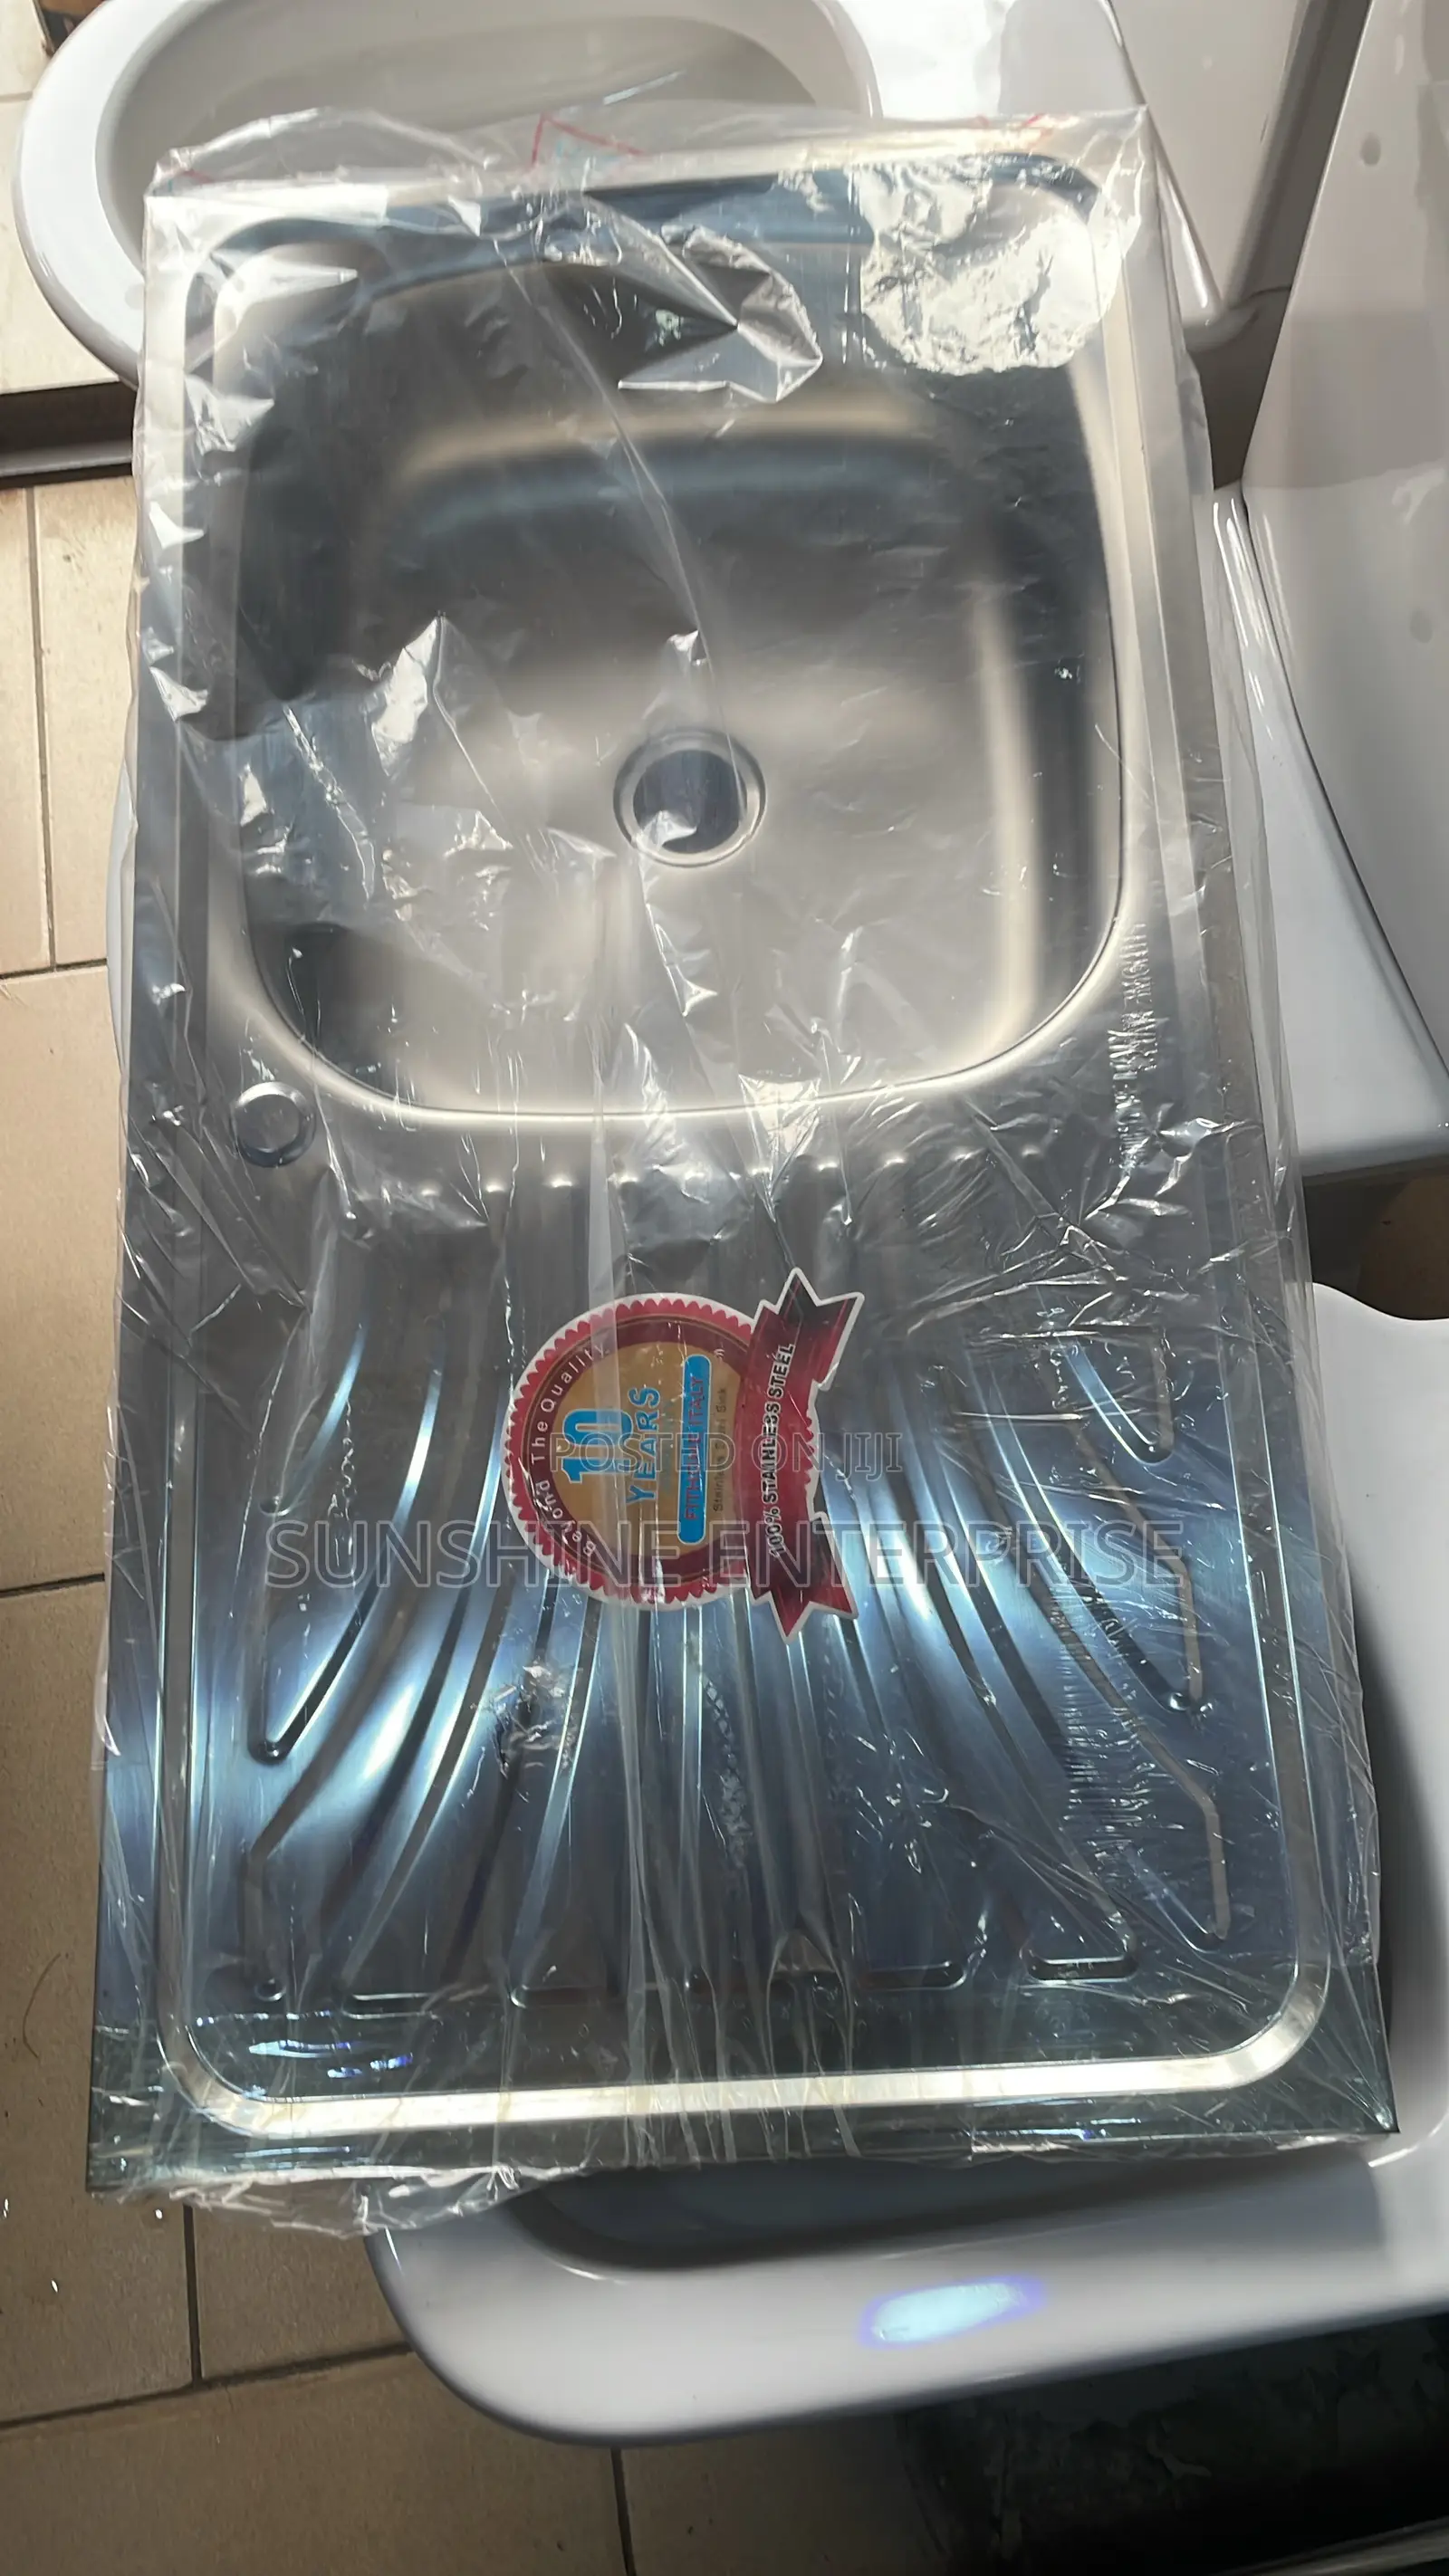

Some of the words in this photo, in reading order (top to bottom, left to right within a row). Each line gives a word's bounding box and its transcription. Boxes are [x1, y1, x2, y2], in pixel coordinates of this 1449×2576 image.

[768, 1343, 796, 1399] STEEL
[531, 1422, 548, 1465] The
[561, 1408, 634, 1484] 10
[626, 1387, 661, 1505] YEARS
[761, 1401, 781, 1504] STAINLESS
[536, 1479, 597, 1557] Beyond
[764, 1506, 785, 1557] 100%
